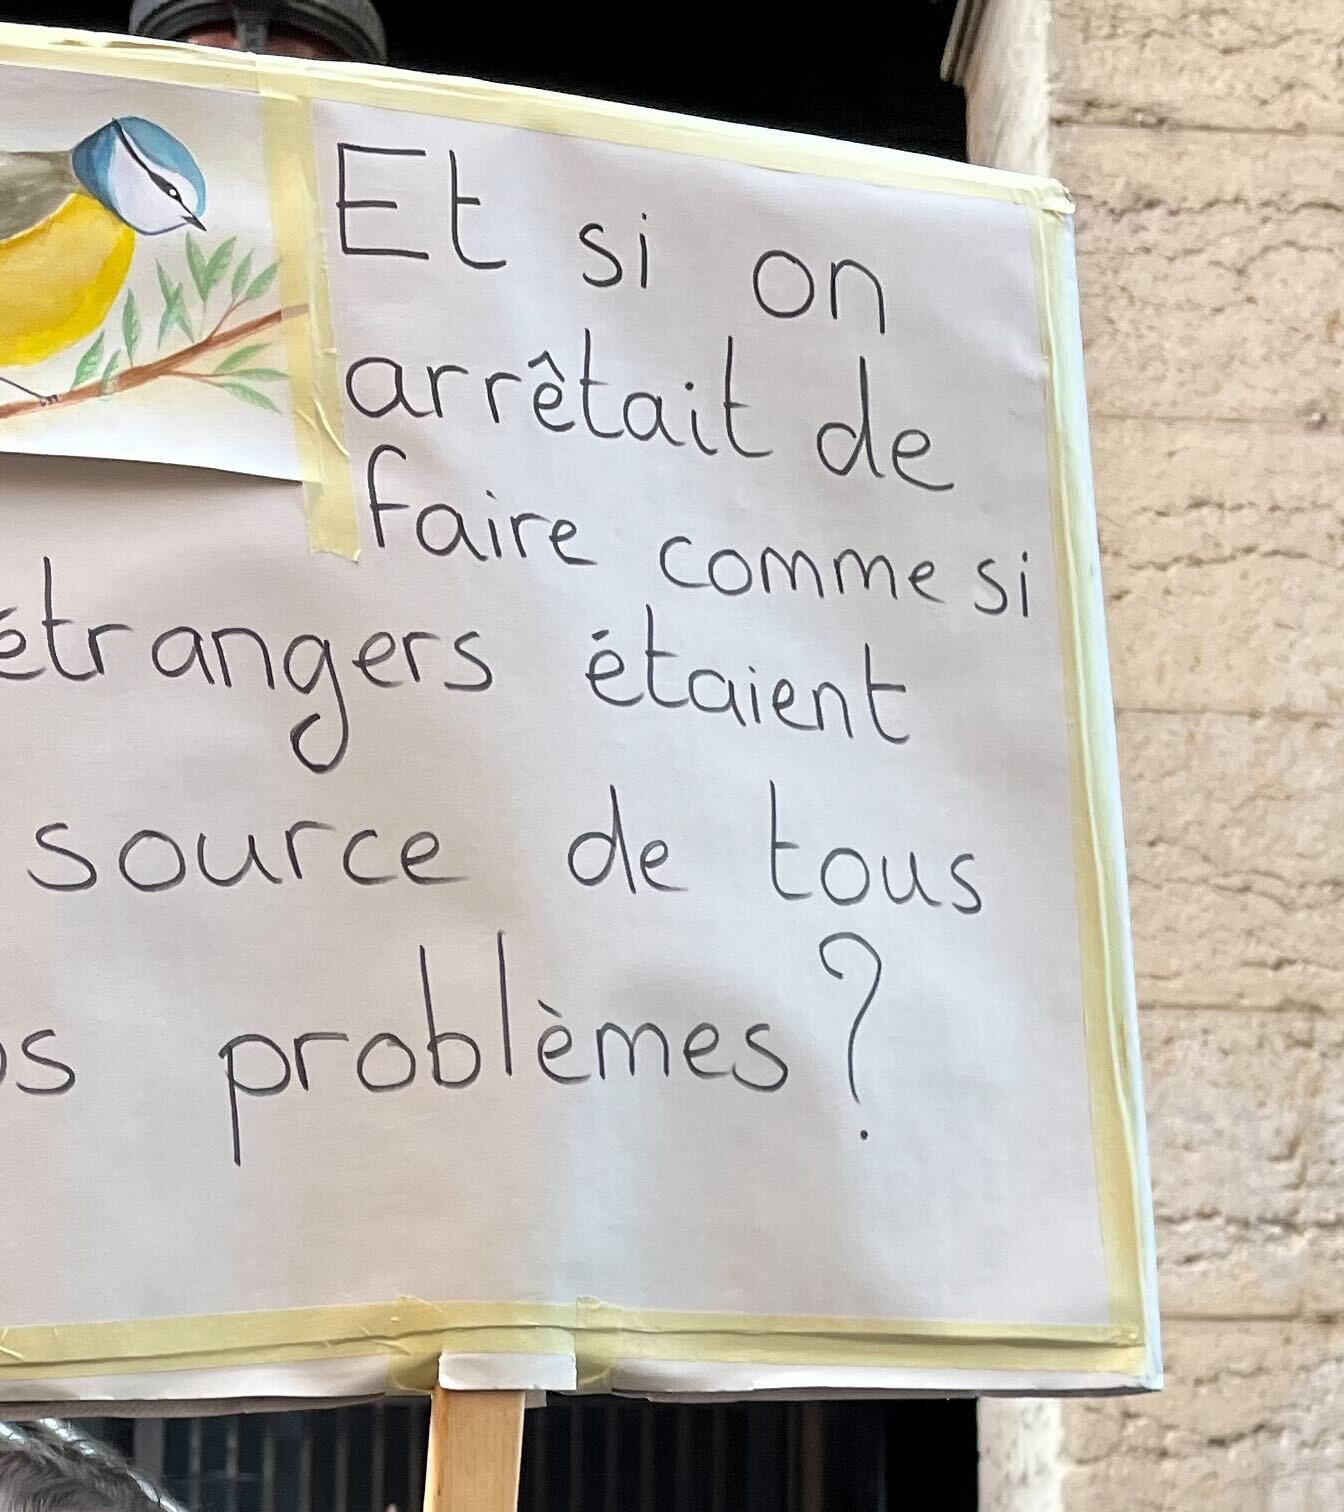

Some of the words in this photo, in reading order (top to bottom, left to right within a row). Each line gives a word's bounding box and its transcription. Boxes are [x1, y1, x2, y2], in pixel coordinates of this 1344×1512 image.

[334, 140, 506, 271] Et
[577, 210, 650, 291] si
[751, 247, 888, 336] on
[343, 326, 775, 460] arrêtait
[814, 354, 957, 494] de
[365, 441, 600, 567] faire
[658, 534, 947, 604] comme
[972, 549, 1033, 619] si
[583, 602, 912, 747] étaient
[25, 818, 470, 894] source
[566, 782, 689, 896] de
[767, 778, 984, 916] tous
